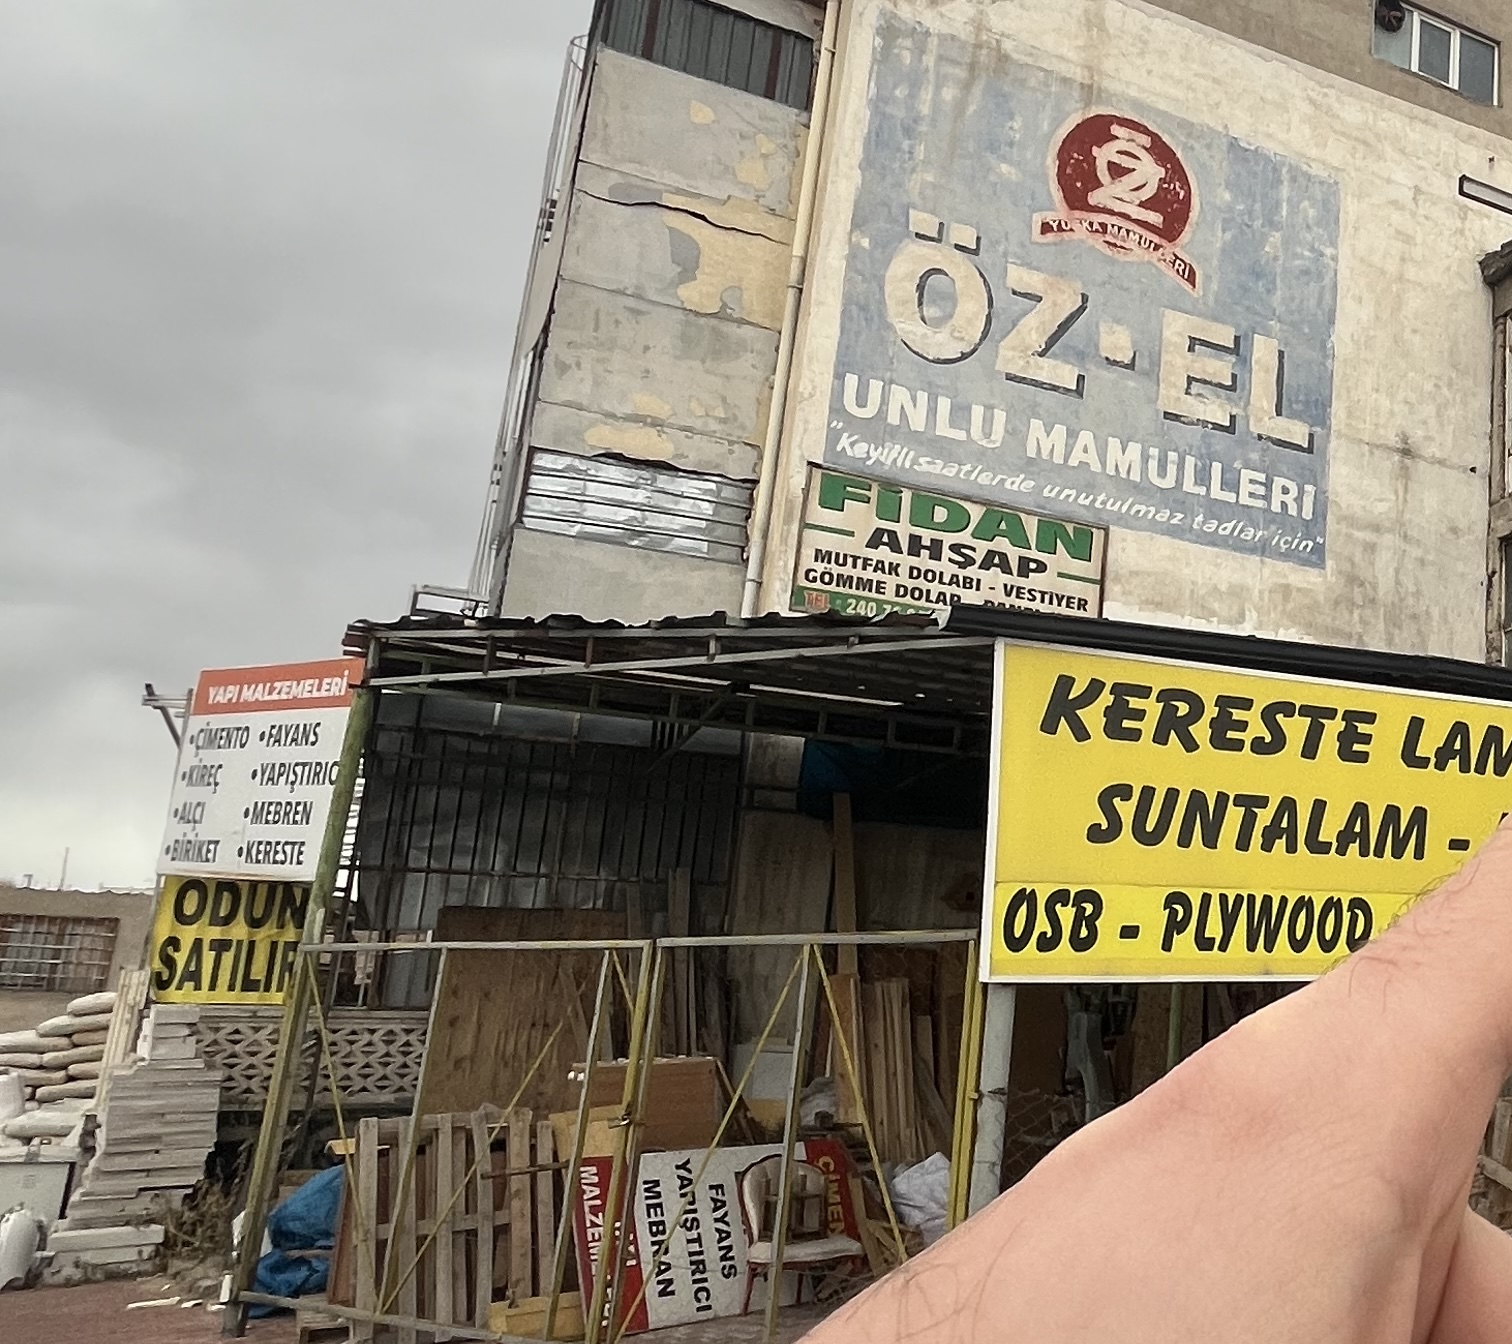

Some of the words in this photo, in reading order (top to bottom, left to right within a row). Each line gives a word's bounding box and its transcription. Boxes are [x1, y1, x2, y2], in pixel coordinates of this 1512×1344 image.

[843, 372, 1007, 449] UNLU
[1042, 483, 1185, 526] unutulmaz
[1192, 512, 1265, 543] tadlar
[865, 527, 1048, 580] AHŞAP
[803, 567, 887, 595] GÖMME
[813, 548, 901, 578] MUTFAK
[908, 565, 982, 592] DOLABI
[1002, 582, 1089, 613] VESTİYER
[208, 684, 240, 705] YAPI
[240, 669, 349, 703] MALZEMELERİ
[195, 721, 250, 756] ÇİMENTO
[265, 722, 321, 748] FAYANS
[1039, 673, 1378, 764] KERESTE
[185, 757, 224, 794] KİREÇ
[177, 801, 206, 832] ALÇI
[250, 801, 314, 826] MEBREN
[1086, 783, 1429, 860] SUNTALAM
[170, 832, 221, 863] BİRİKET
[244, 840, 306, 866] KERESTE
[173, 878, 311, 930] ODUN
[1003, 887, 1101, 954] OSB
[1161, 890, 1374, 954] PLYWOOD
[642, 1178, 676, 1298] MEBRAN
[674, 1157, 714, 1313] YAPIŞTIRICI
[708, 1182, 738, 1280] FAYANS
